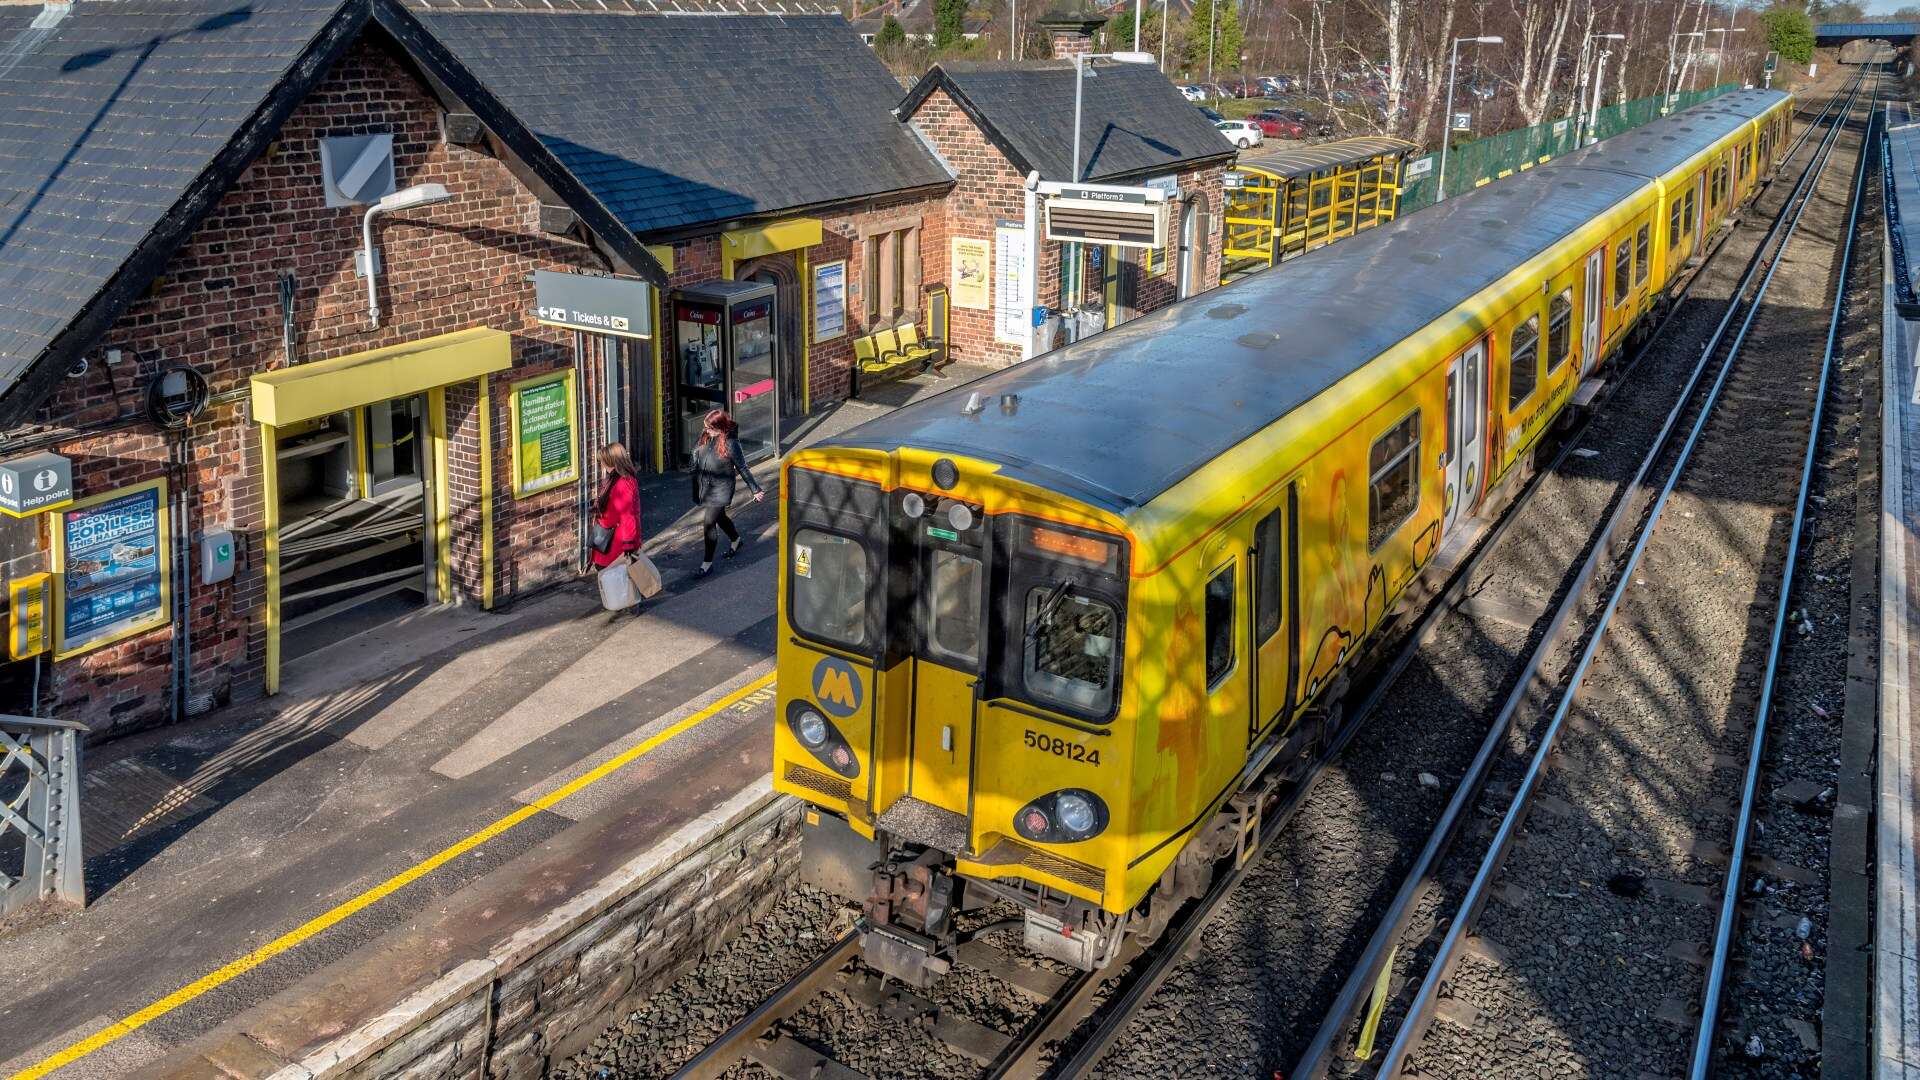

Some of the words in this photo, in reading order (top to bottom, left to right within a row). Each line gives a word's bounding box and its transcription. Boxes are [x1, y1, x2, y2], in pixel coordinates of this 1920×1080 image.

[1458, 117, 1467, 128] 2
[1091, 192, 1119, 201] Platform
[1119, 194, 1124, 202] 2
[572, 310, 603, 326] Tickets
[602, 315, 611, 327] &
[522, 395, 551, 408] Hamilton
[522, 405, 544, 417] Square
[544, 400, 565, 411] station
[522, 417, 528, 426] is
[528, 412, 548, 424] closed
[548, 409, 557, 419] for
[23, 496, 45, 507] Help
[45, 488, 70, 503] point
[68, 509, 122, 531] DISCOVER
[123, 500, 153, 515] MORE
[68, 521, 106, 543] FOR
[110, 508, 154, 531] LESS
[70, 537, 94, 552] THIS
[95, 528, 122, 544] HALF
[124, 519, 154, 535] TERM
[1024, 729, 1101, 768] 508124
